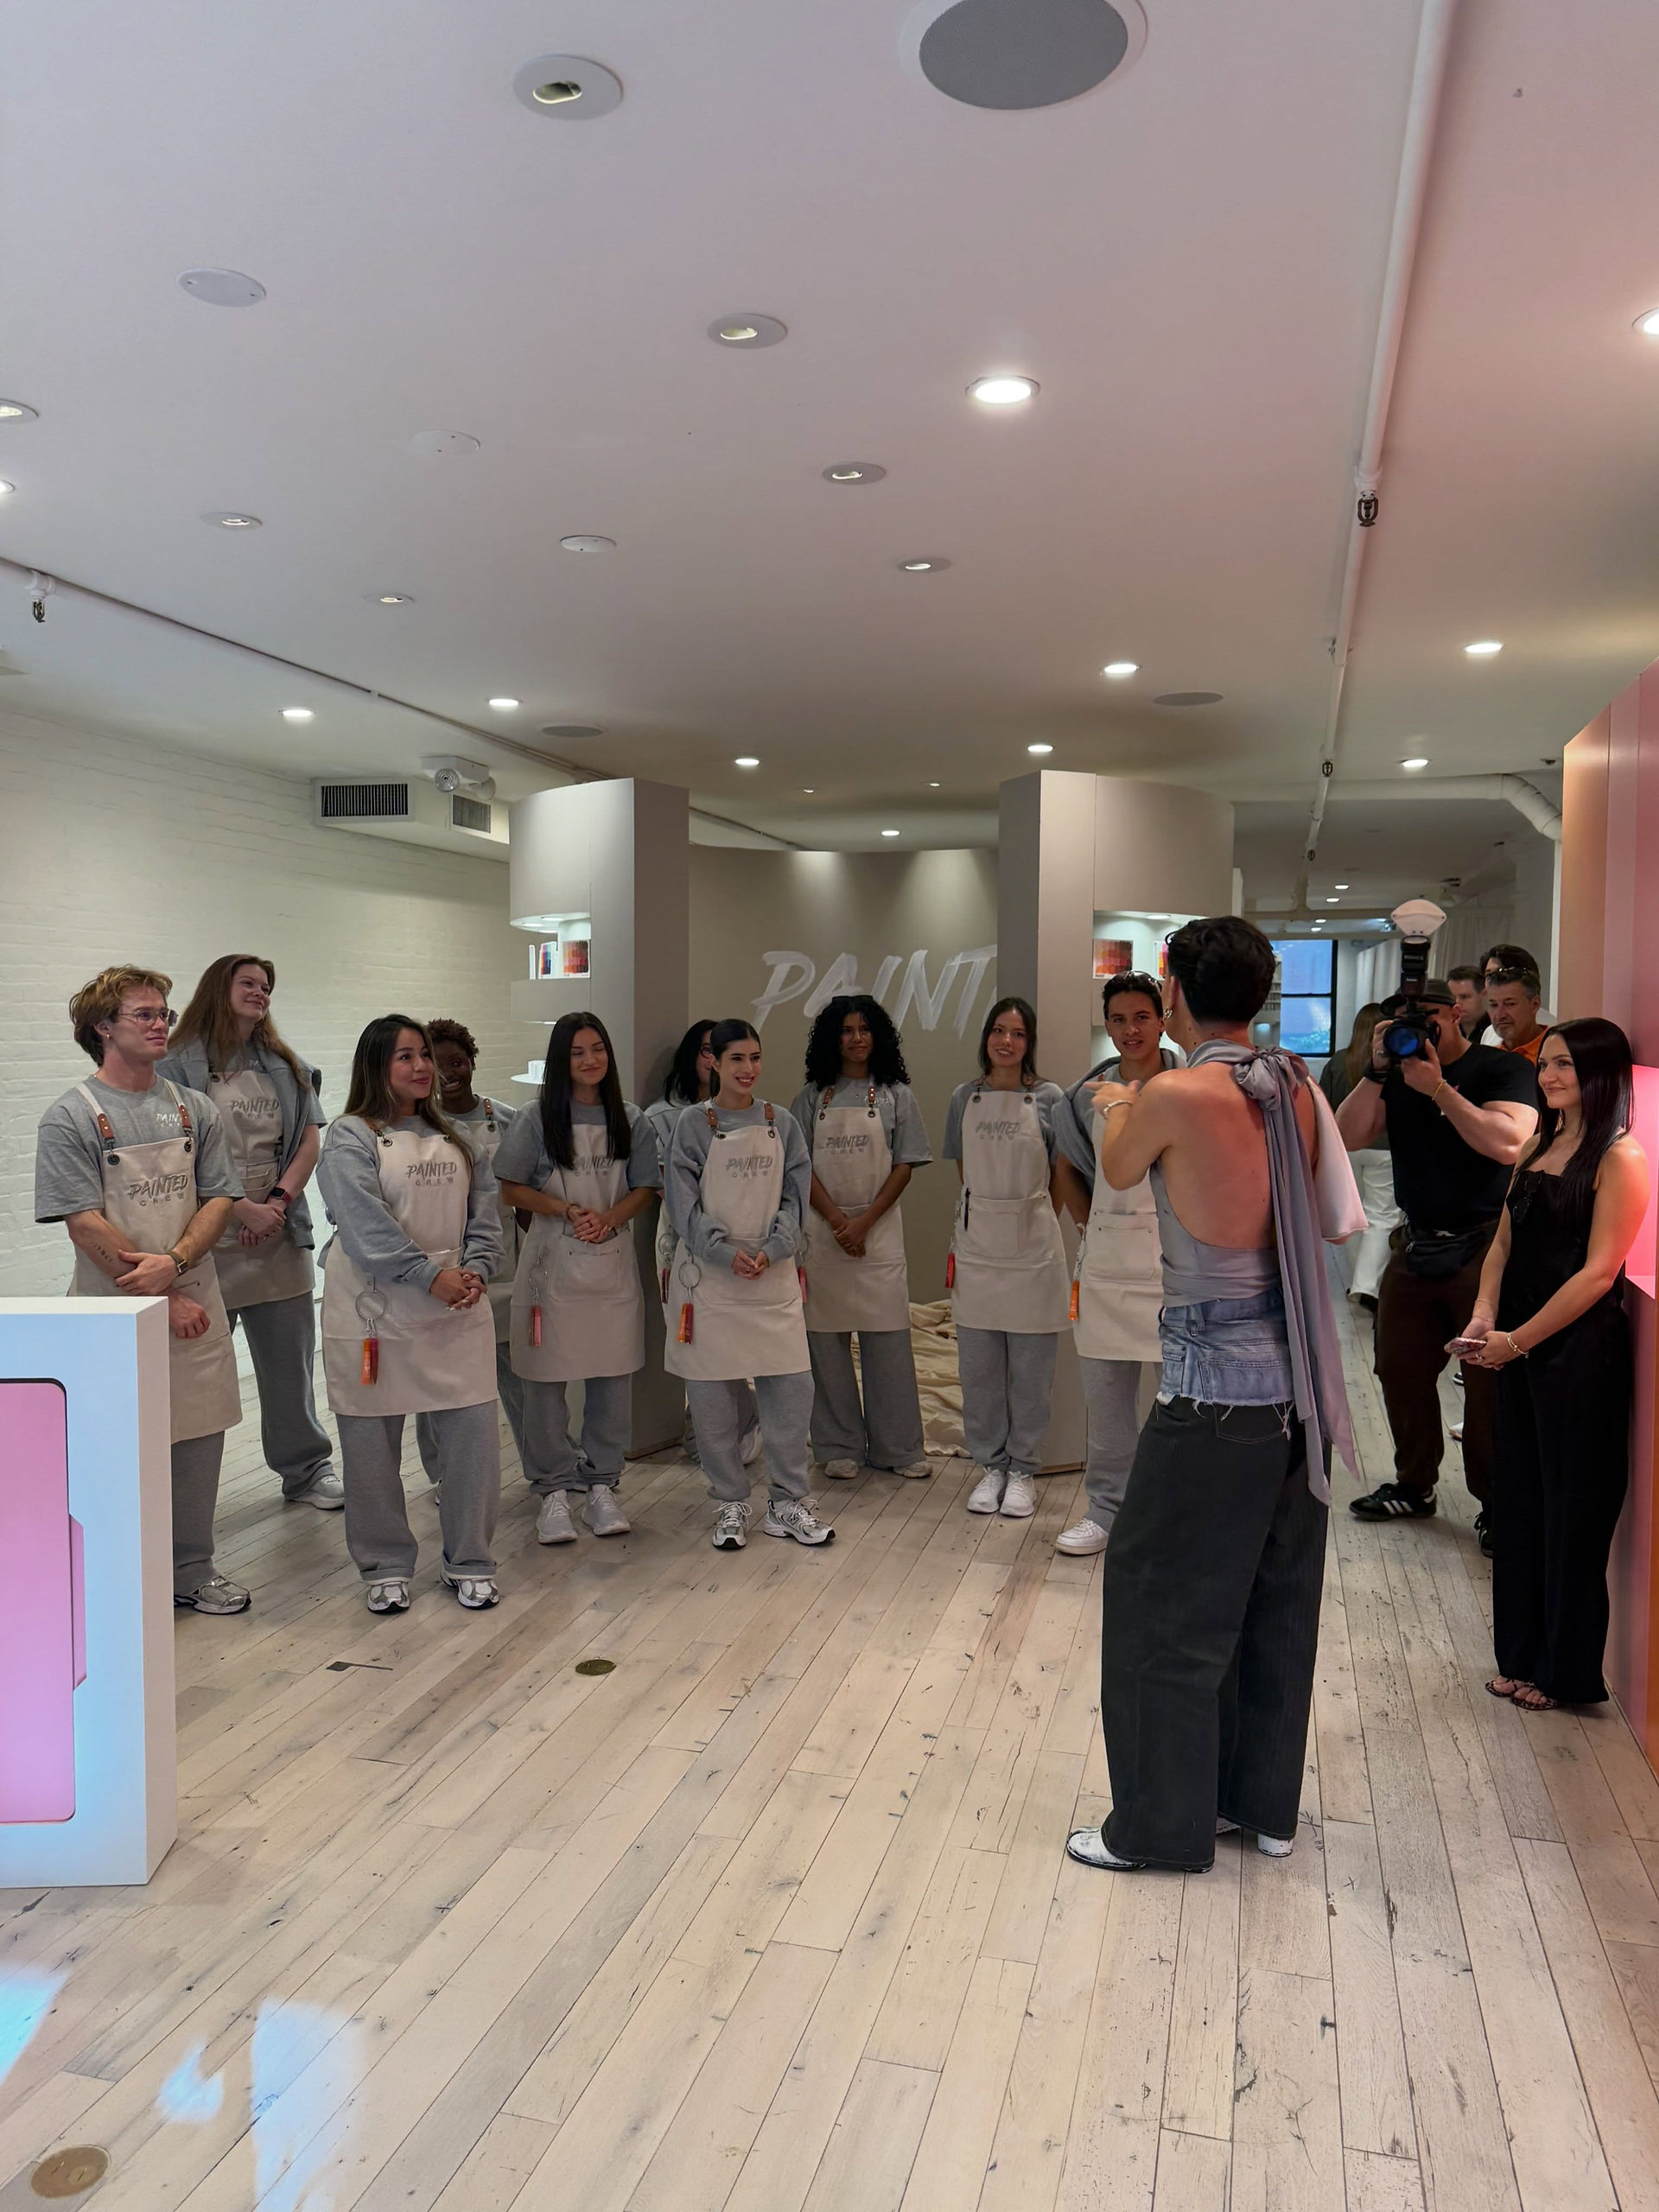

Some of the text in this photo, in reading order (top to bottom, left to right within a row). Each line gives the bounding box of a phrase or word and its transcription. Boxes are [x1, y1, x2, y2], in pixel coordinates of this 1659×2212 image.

[230, 1098, 280, 1113] PAINTED
[976, 1121, 1020, 1134] PAINTED
[826, 1135, 868, 1148] PAINTED
[405, 1161, 457, 1180] PAINTED
[726, 1155, 773, 1172] PAINTED
[129, 1173, 188, 1199] PAINTED
[139, 1192, 186, 1207] CREW
